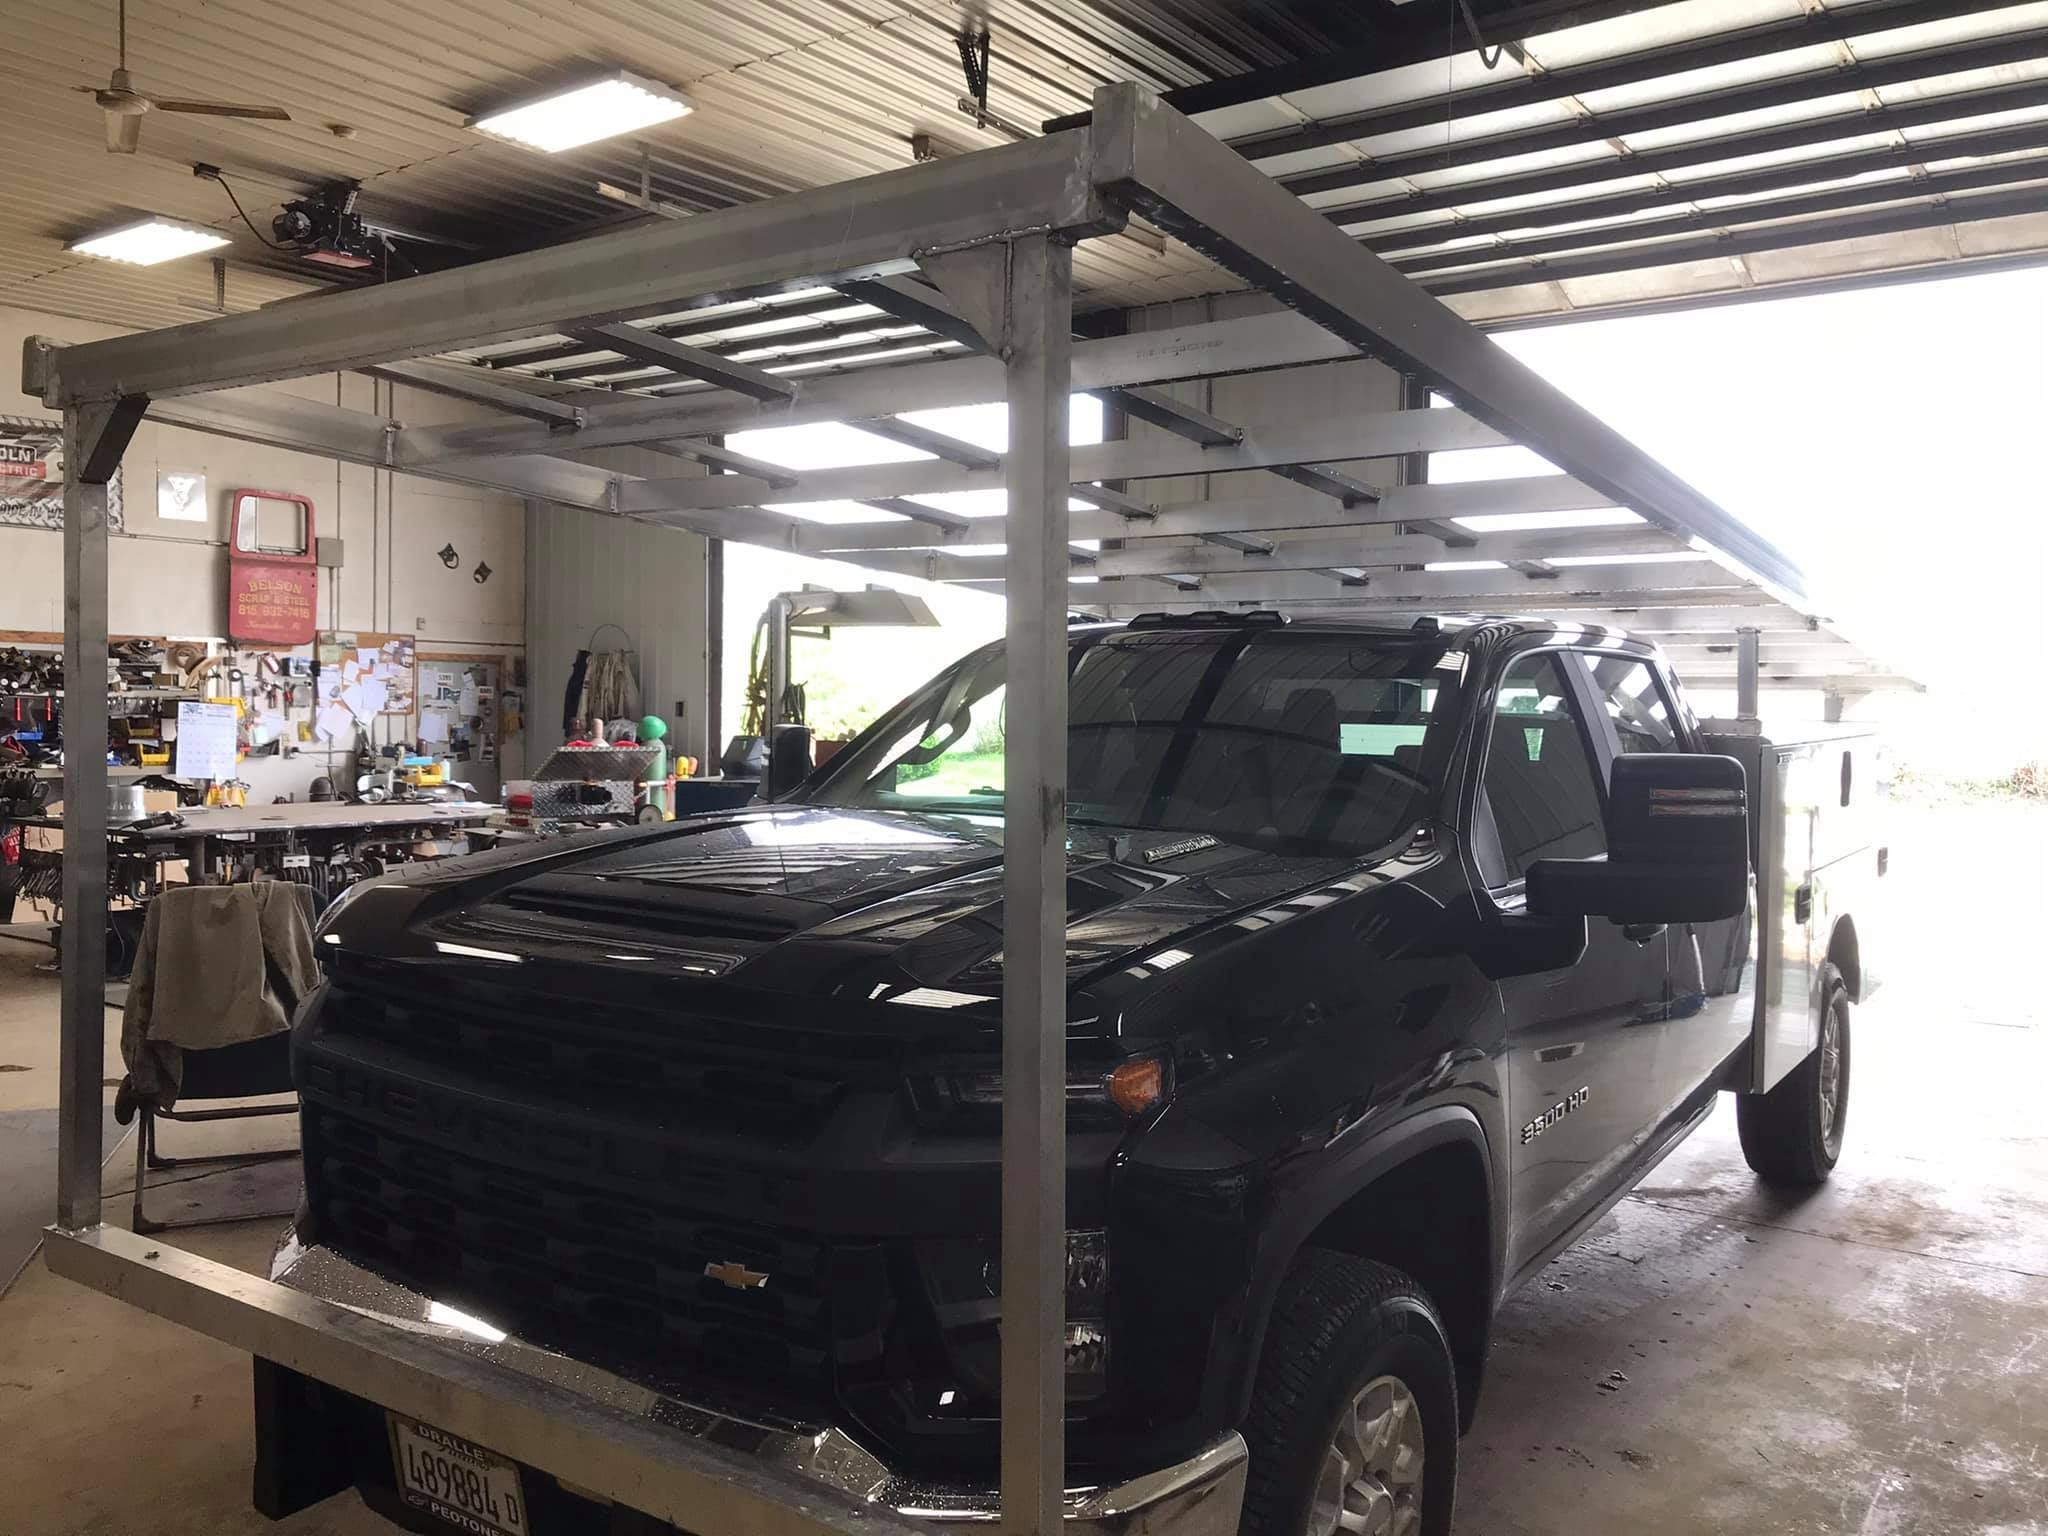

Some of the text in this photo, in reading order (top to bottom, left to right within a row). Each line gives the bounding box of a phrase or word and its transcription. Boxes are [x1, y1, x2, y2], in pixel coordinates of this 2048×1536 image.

[239, 593, 269, 603] SCRAP
[284, 596, 310, 607] STEEL
[248, 579, 303, 594] BELSON
[1521, 1086, 1589, 1145] 3500 HD
[418, 1424, 486, 1461] DRALLE
[407, 1443, 500, 1522] 489884
[504, 1493, 520, 1525] D
